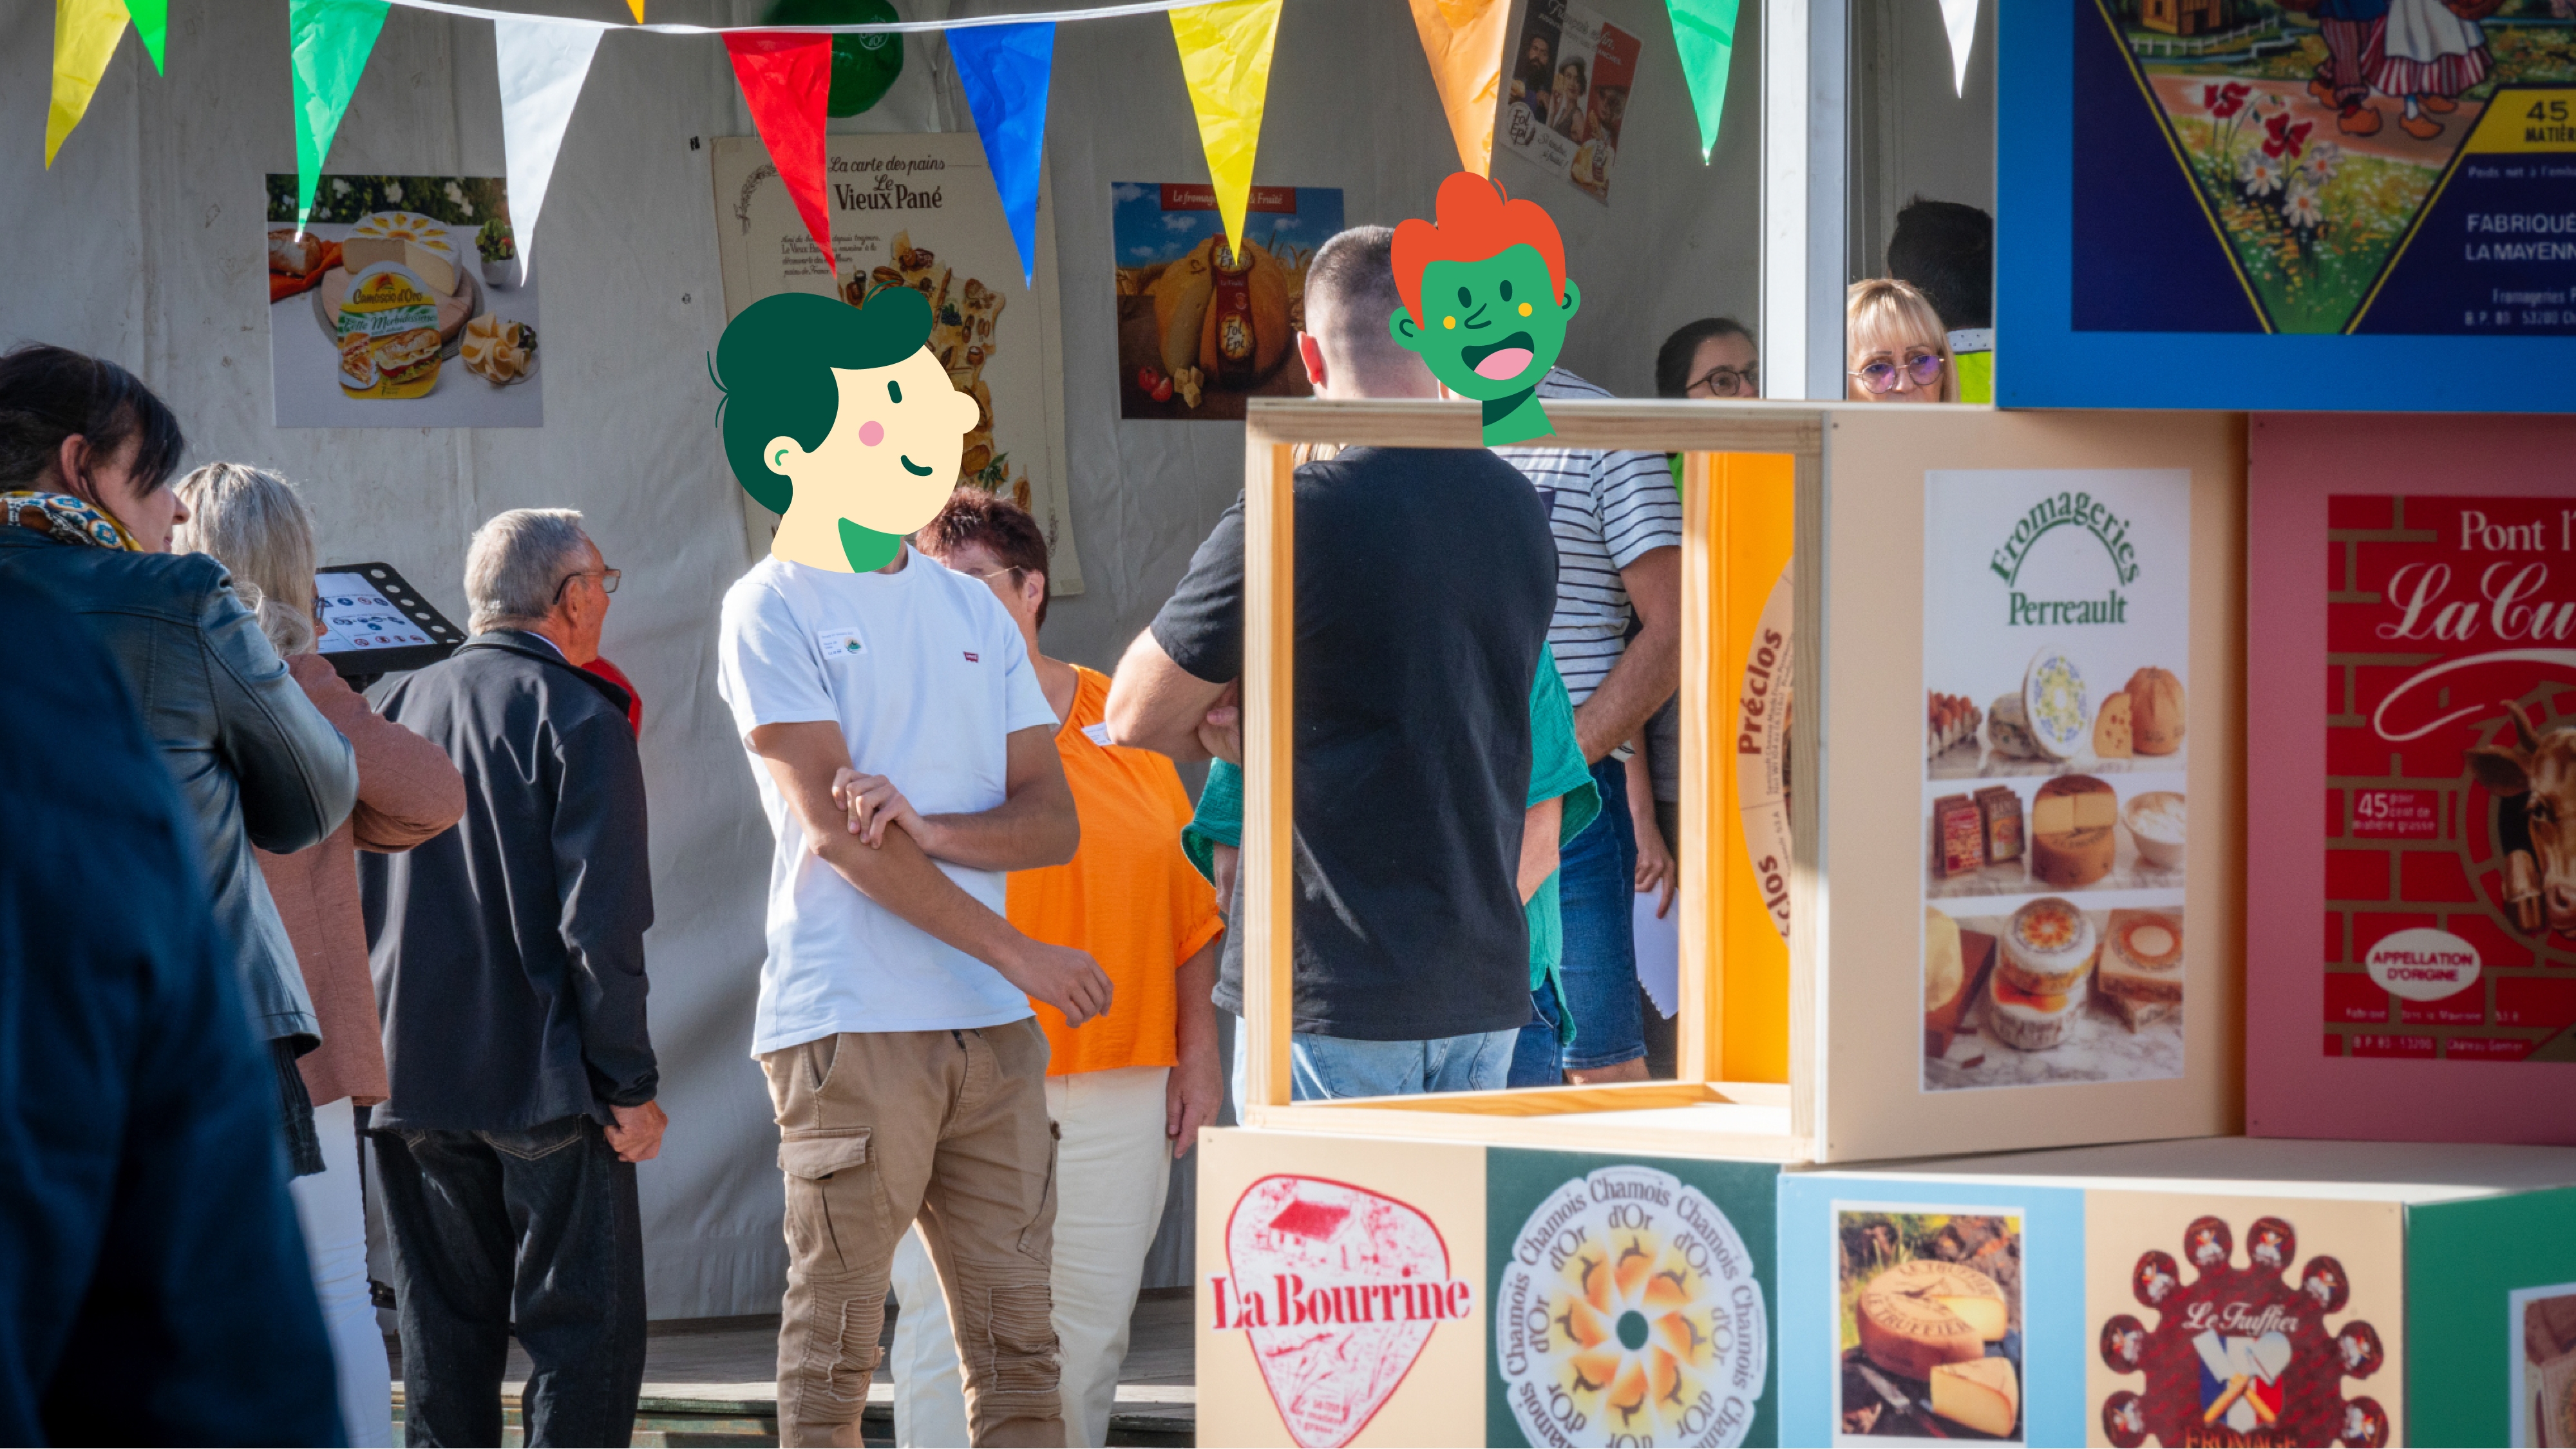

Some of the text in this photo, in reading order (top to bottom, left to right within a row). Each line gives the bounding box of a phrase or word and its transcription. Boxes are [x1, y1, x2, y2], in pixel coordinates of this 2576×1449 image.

[2526, 100, 2569, 122] 45
[828, 155, 945, 176] La carte des pains
[873, 174, 894, 192] Le
[833, 184, 943, 211] Vieux Pané
[1173, 190, 1183, 202] Le
[1183, 191, 1215, 205] fromag
[1258, 193, 1282, 205] Fruité
[2465, 242, 2576, 261] LA MAYENN
[353, 289, 423, 305] Camoscio d'Oro
[1990, 492, 2139, 584] Fromageries
[2459, 509, 2546, 551] Pont
[2007, 589, 2128, 625] Perreault
[2376, 561, 2576, 641] La Cu
[1738, 628, 1783, 755] Préclos
[2358, 793, 2389, 819] 45
[2372, 951, 2474, 966] APPELLATION
[2387, 969, 2459, 982] D'ORIGINE
[1589, 1176, 1671, 1230] Chamois d'Or
[1519, 1193, 1587, 1272] Chamois d'Or
[1674, 1195, 1739, 1280] Chamois d'Or
[1211, 1274, 1471, 1330] La Bourrine
[2182, 1302, 2217, 1330] Le
[1506, 1273, 1550, 1376] Chamois d'Or
[1712, 1285, 1755, 1390] Chamois d'Or
[1517, 1381, 1587, 1448] amois d'Or
[1676, 1390, 1714, 1439] d'Or
